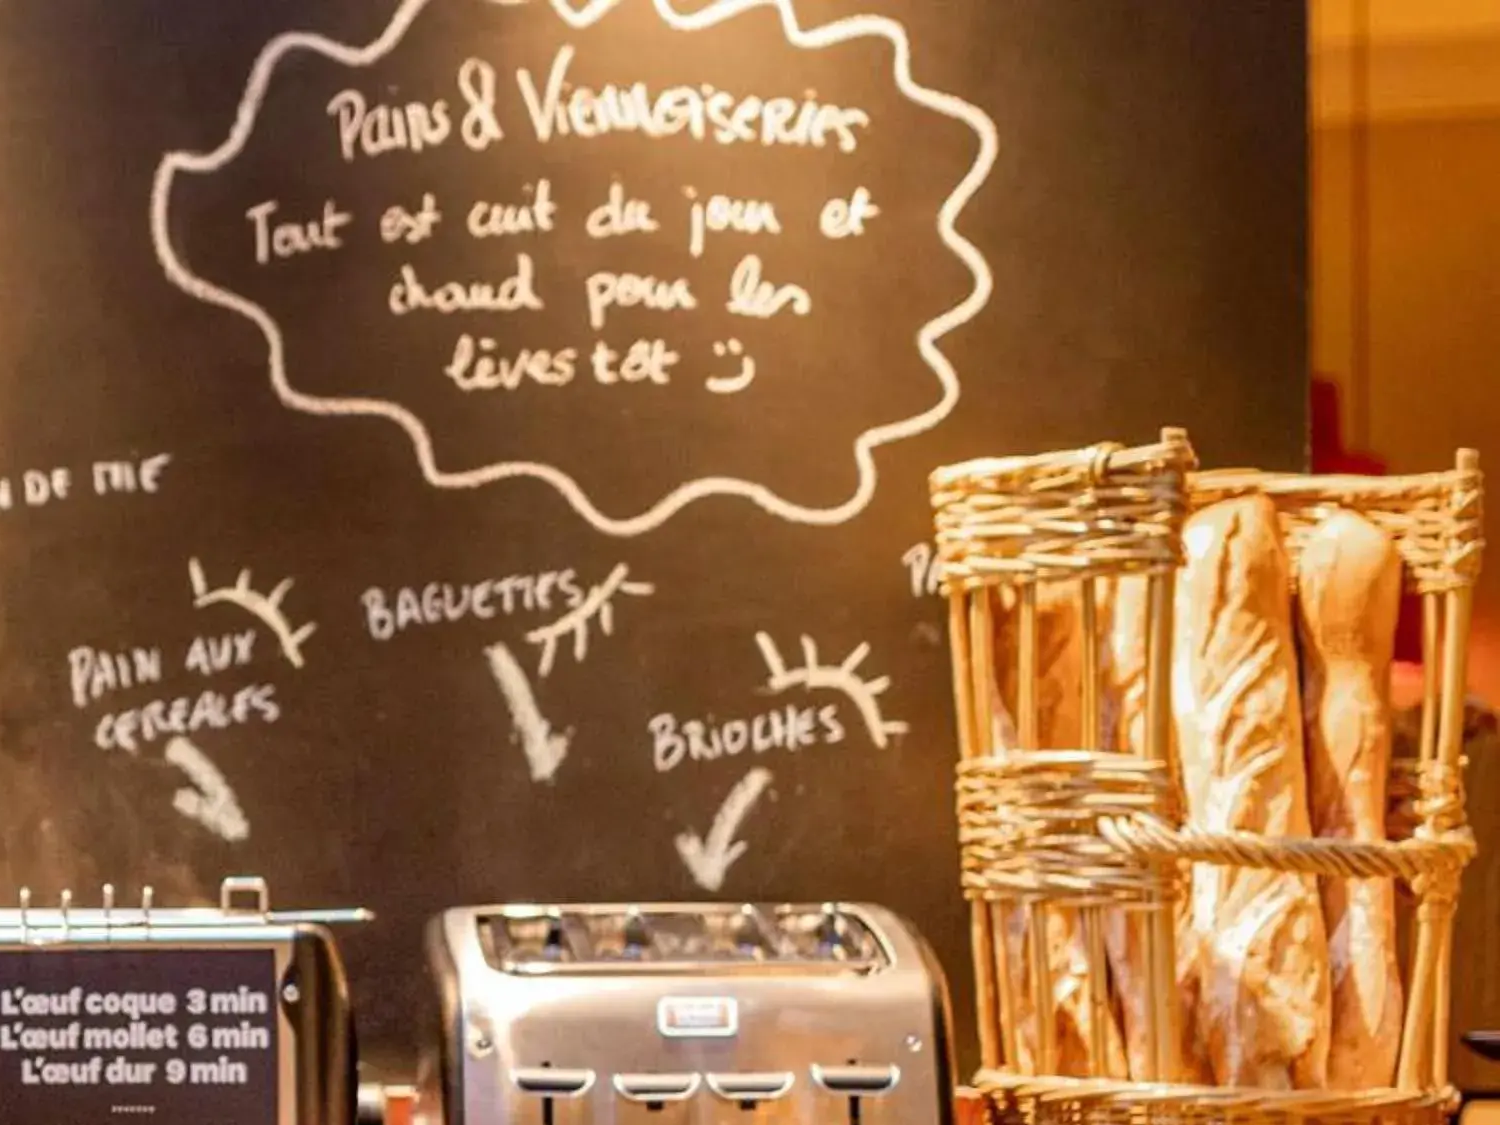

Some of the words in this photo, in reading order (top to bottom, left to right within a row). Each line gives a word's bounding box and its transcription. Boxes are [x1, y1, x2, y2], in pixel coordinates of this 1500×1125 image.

[327, 87, 451, 161] Pains
[458, 56, 504, 150] &
[246, 198, 352, 264] Tout
[379, 192, 441, 244] est
[466, 178, 558, 238] cuit
[586, 181, 660, 239] du
[681, 185, 782, 258] jour
[819, 186, 881, 239] et
[388, 253, 545, 315] chaud
[585, 271, 698, 331] pour
[725, 253, 812, 319] les
[23, 467, 71, 506] DE
[360, 567, 583, 641] BAGUETTES
[67, 645, 162, 709] PAIN
[185, 629, 257, 676] AUX
[83, 1021, 179, 1050] mollet
[187, 1023, 208, 1050] 6
[211, 1020, 270, 1050] min
[85, 990, 177, 1021] coque
[186, 988, 207, 1016] 3
[209, 985, 268, 1015] min
[105, 1056, 157, 1085] dur
[165, 1058, 187, 1085] 9
[190, 1055, 248, 1085] min
